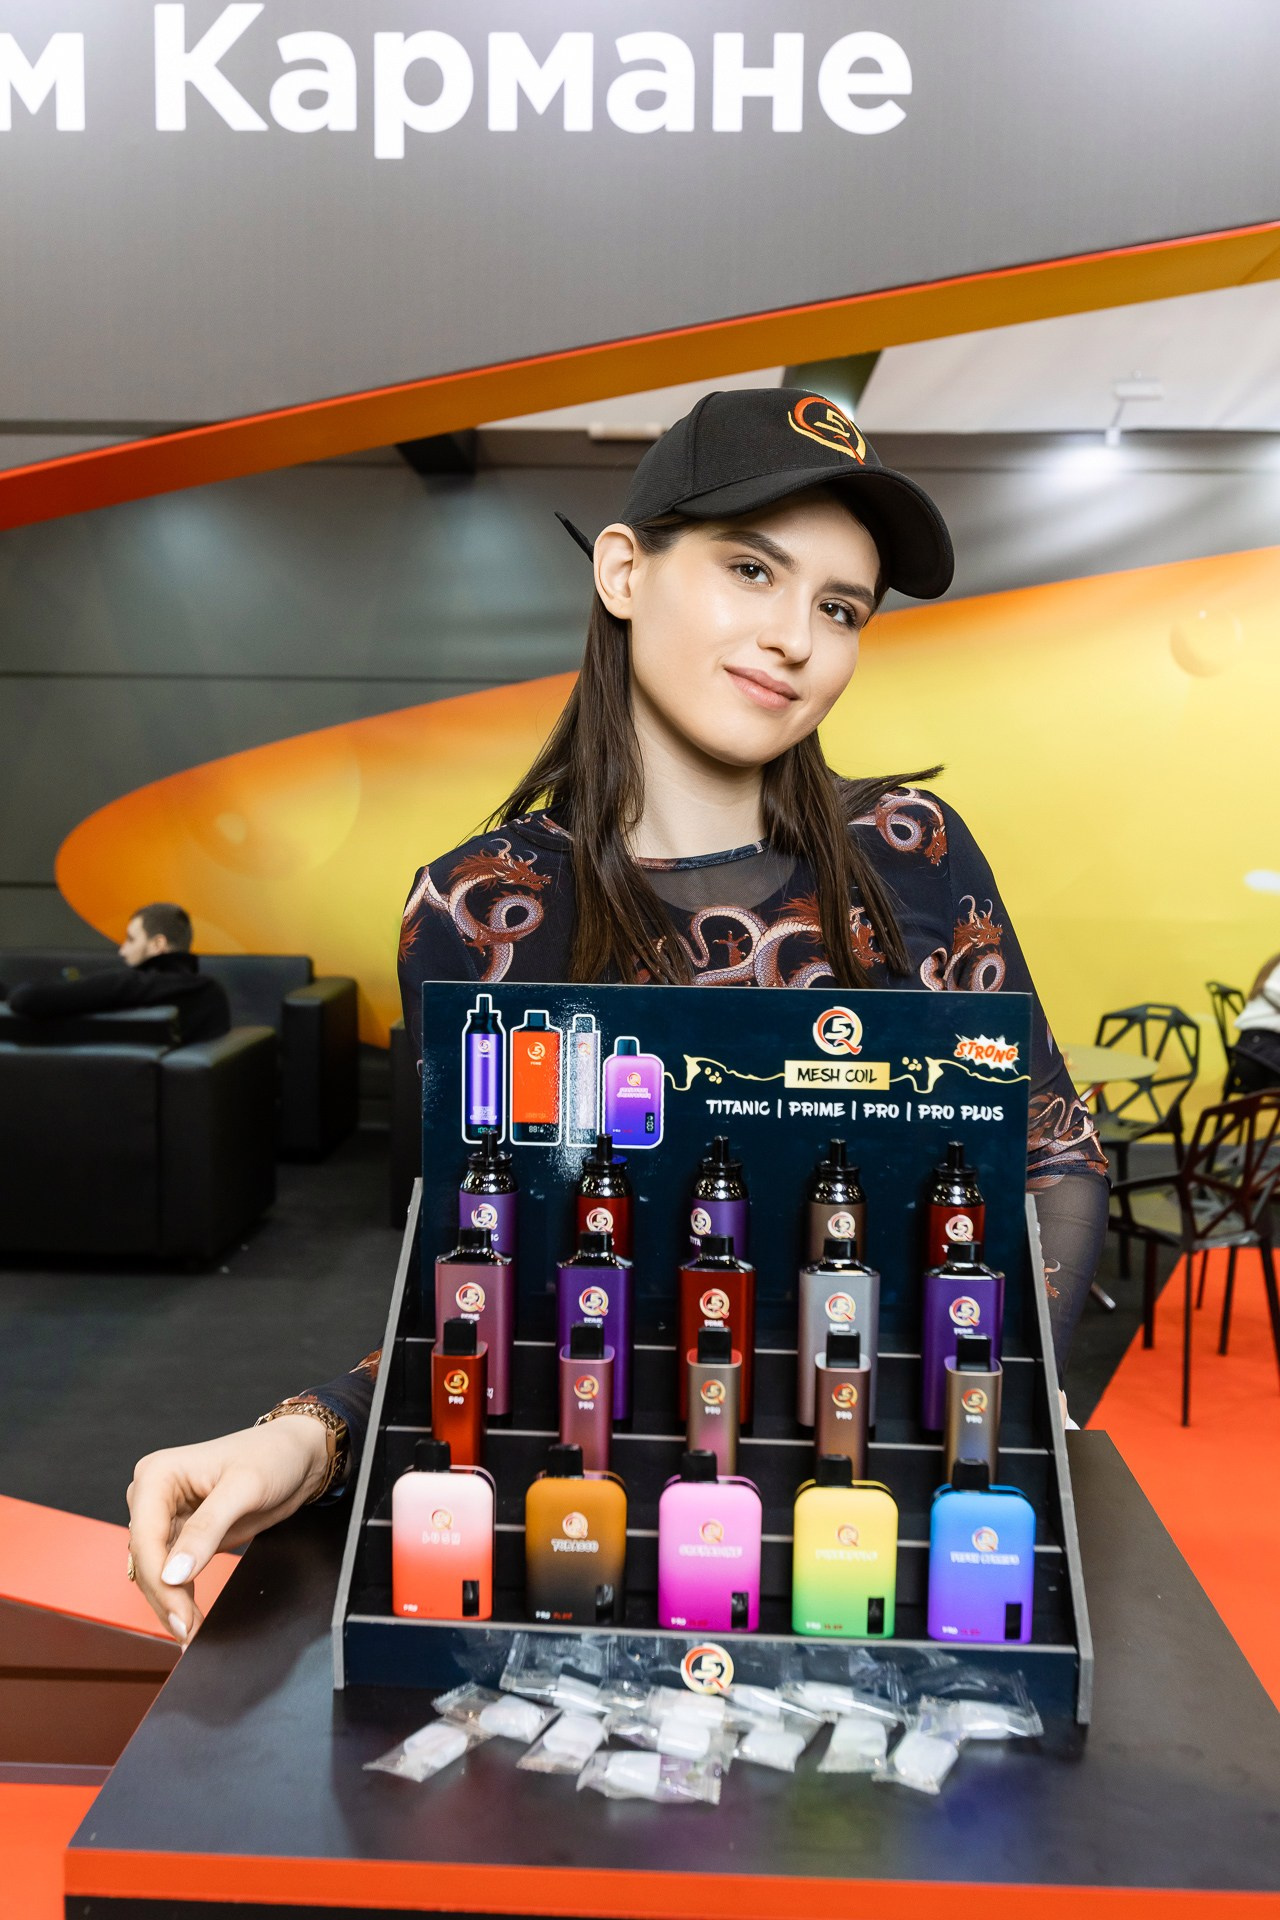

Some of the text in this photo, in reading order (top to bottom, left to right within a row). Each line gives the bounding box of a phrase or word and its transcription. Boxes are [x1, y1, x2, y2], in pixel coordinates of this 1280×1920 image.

[154, 2, 913, 159] Кармане
[955, 1041, 1018, 1064] STRONG
[797, 1067, 878, 1083] MESH COIL
[706, 1099, 771, 1116] TITANIC
[788, 1100, 846, 1117] PRIME
[863, 1102, 900, 1119] PRO
[918, 1104, 955, 1120] PRO
[960, 1104, 1004, 1121] PLUS
